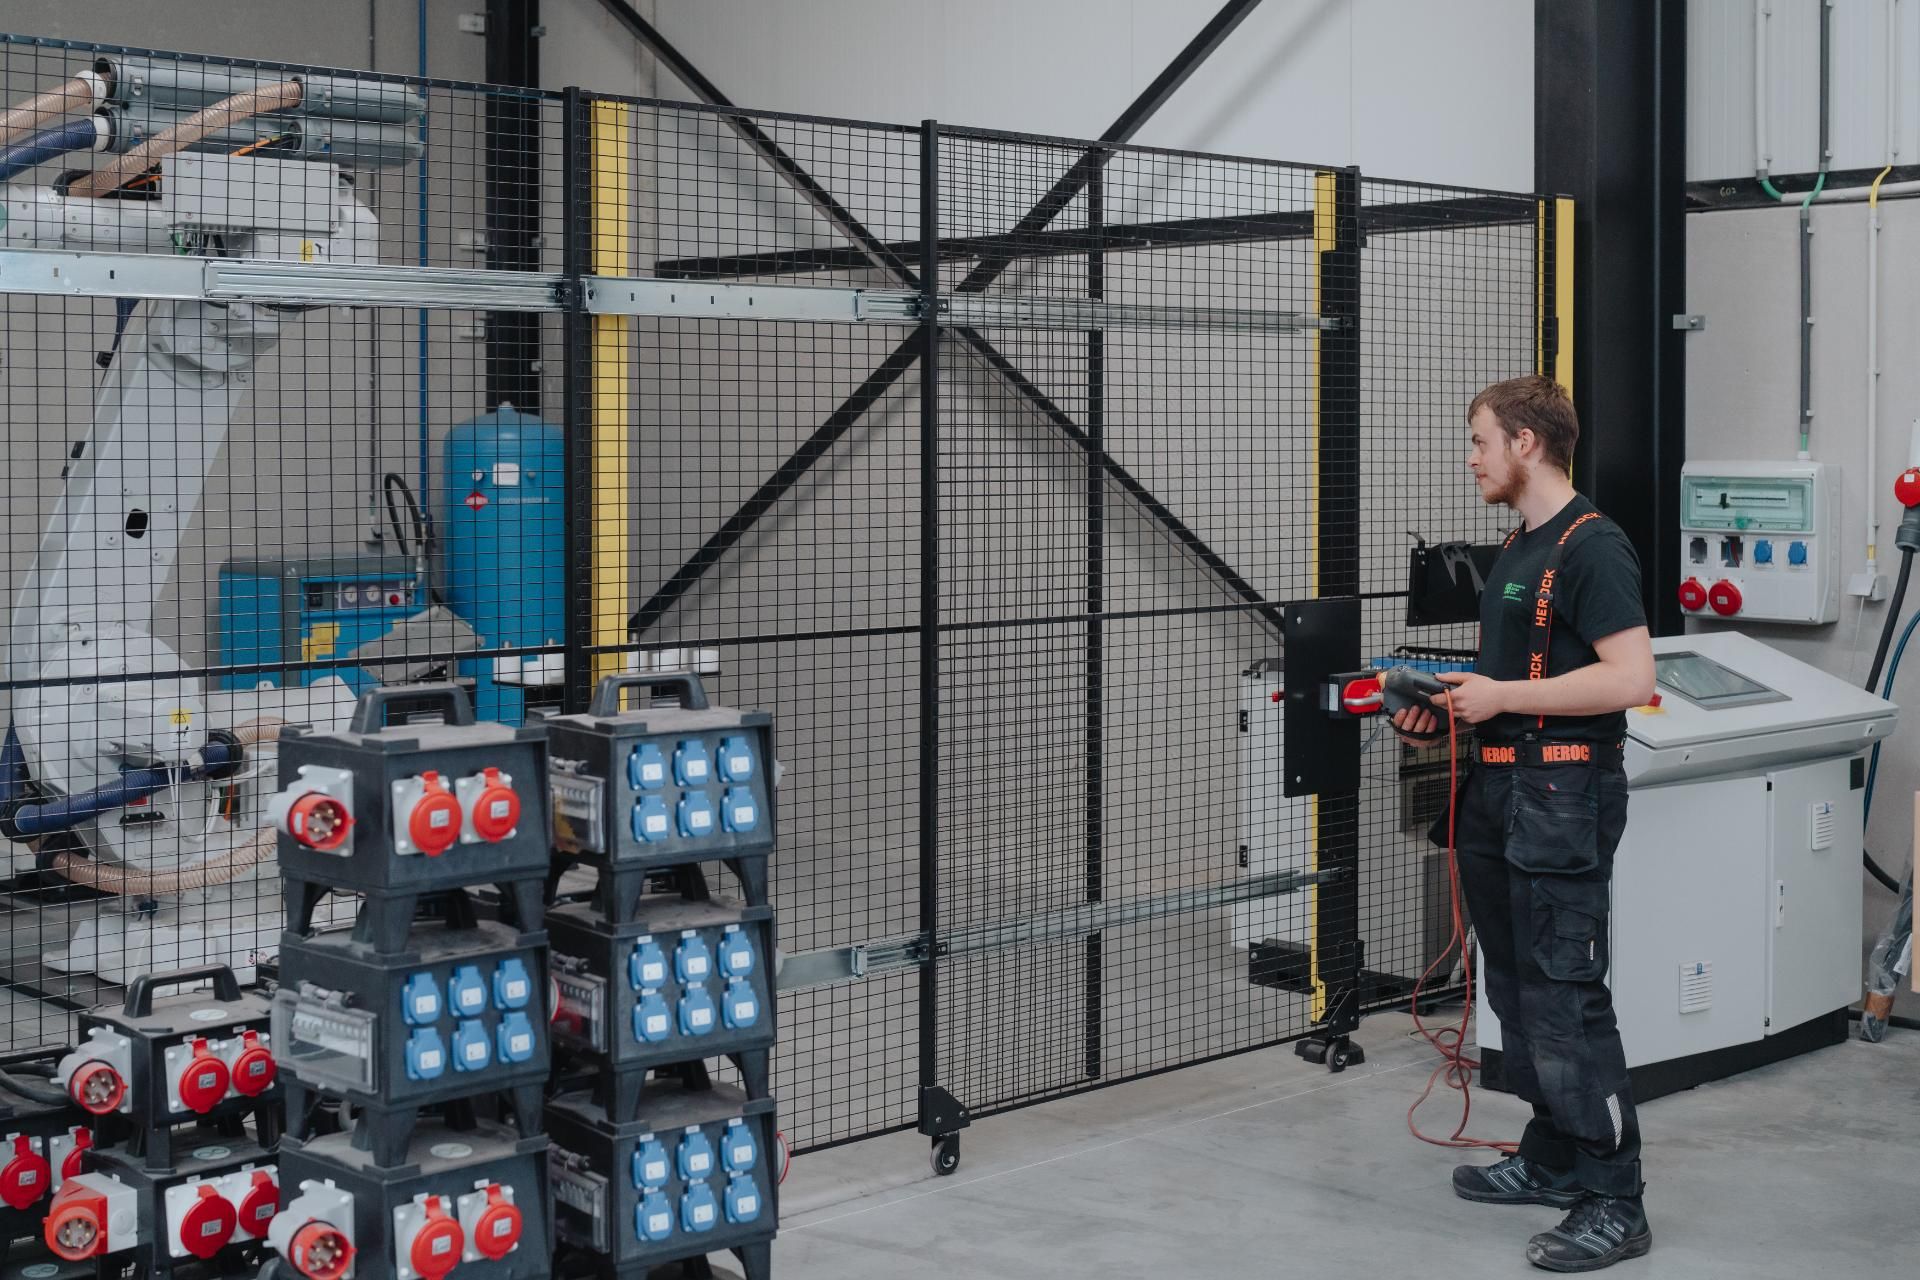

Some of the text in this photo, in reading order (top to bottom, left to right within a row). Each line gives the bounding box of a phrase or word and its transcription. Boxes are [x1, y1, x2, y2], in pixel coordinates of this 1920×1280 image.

[1529, 653, 1543, 680] OCK
[1482, 746, 1516, 762] HEROC
[1542, 745, 1590, 762] HEROC
